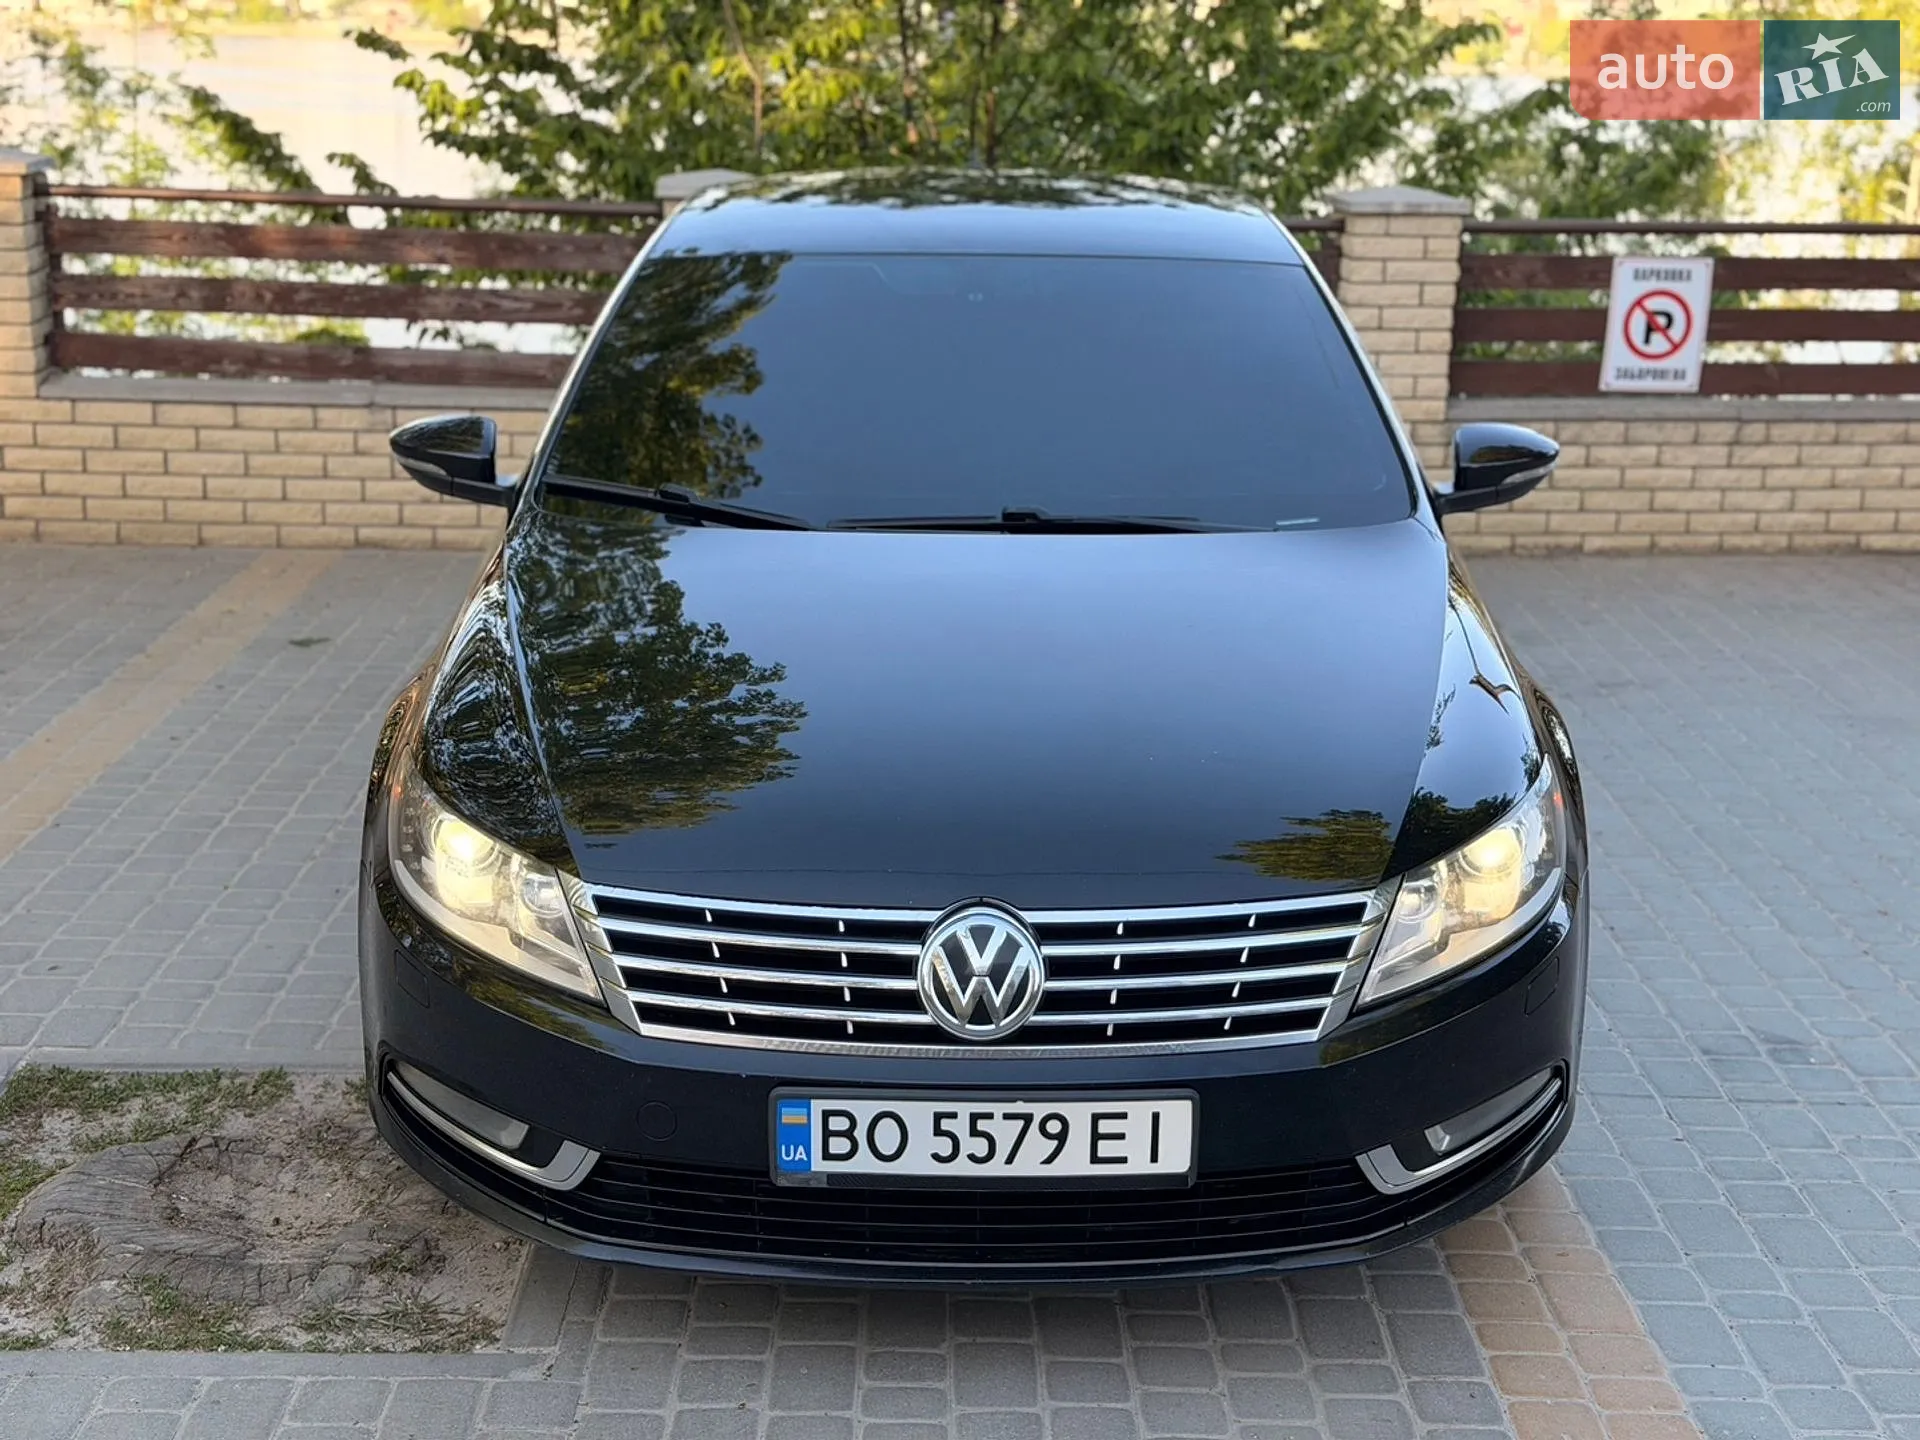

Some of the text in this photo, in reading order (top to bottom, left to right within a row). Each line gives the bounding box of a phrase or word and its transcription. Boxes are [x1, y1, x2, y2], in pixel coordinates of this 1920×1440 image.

[781, 1144, 808, 1162] UA
[821, 1109, 1161, 1166] BO 5579 EI
